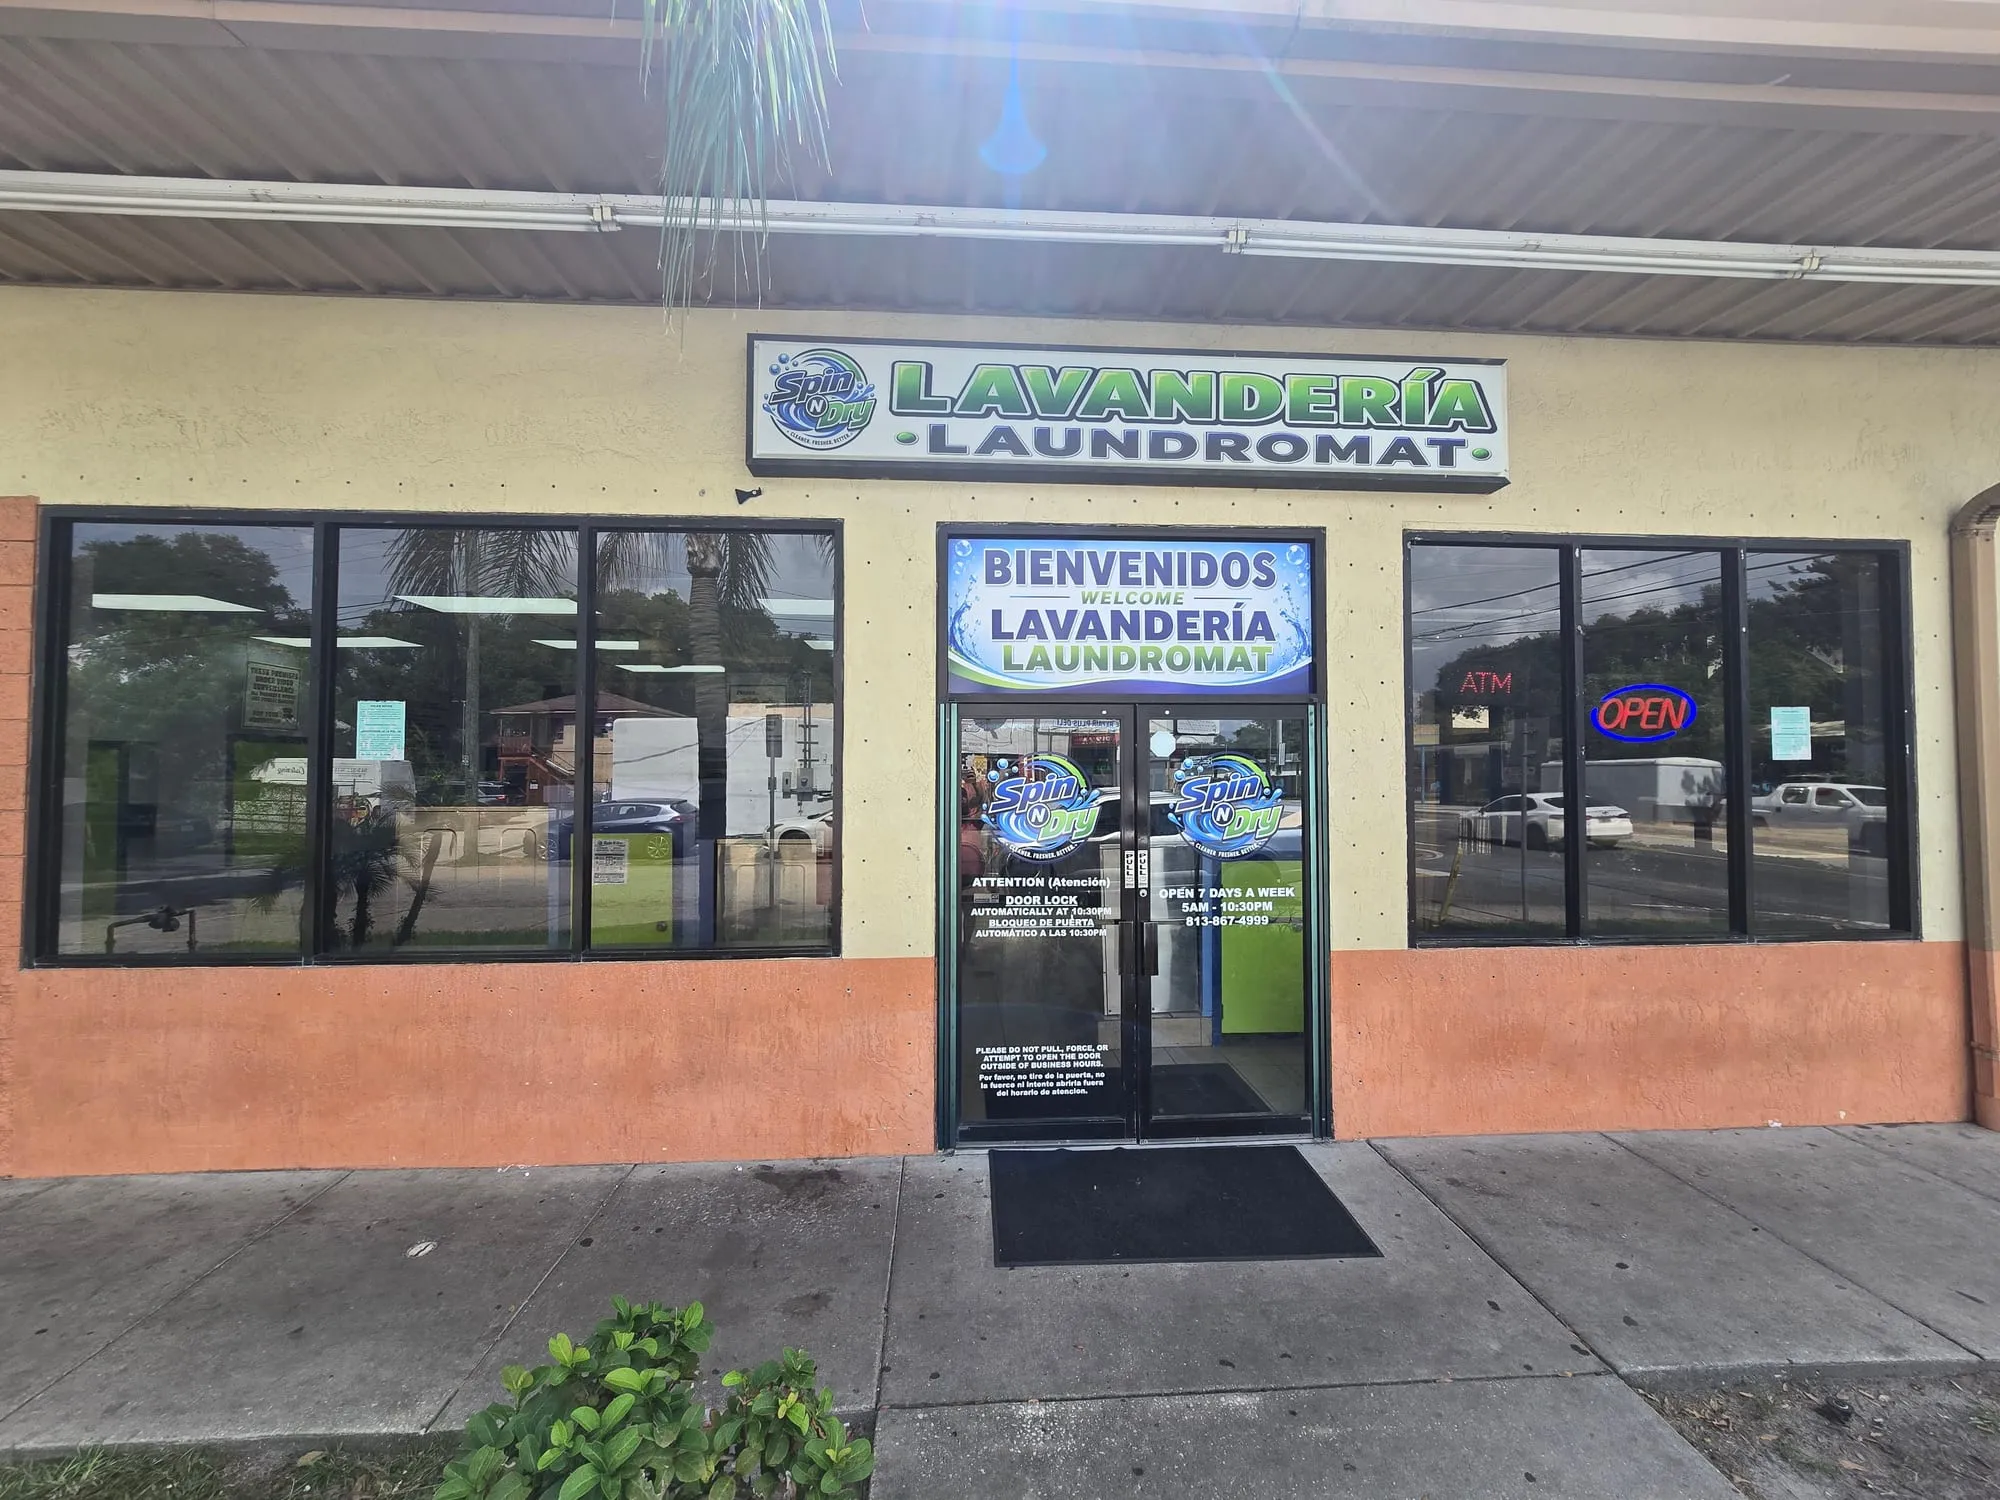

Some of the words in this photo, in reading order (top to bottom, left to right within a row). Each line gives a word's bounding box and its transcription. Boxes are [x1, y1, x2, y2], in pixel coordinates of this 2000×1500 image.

[768, 367, 854, 404] Spin
[891, 361, 1495, 431] LAVANDERÍA
[815, 398, 877, 430] Dry
[928, 423, 1468, 467] LAUNDROMAT
[984, 548, 1277, 588] BIENVENIDOS
[1080, 591, 1185, 606] WELCOME
[990, 602, 1276, 642] LAVANDERÍA
[1003, 645, 1273, 672] LAUNDROMAT
[1460, 672, 1512, 694] ATM
[1598, 697, 1688, 730] OPEN
[988, 773, 1078, 814] Spin
[1175, 773, 1260, 813] Spin
[1038, 806, 1100, 841] Dry
[1222, 805, 1284, 840] Dry
[972, 878, 1045, 887] ATTENTION
[1048, 877, 1110, 888] (Atención)
[1159, 888, 1194, 899] OPEN
[1198, 889, 1205, 898] 7
[1209, 888, 1242, 898] DAYS
[1245, 888, 1254, 897] A
[1258, 887, 1295, 897] WEEK
[971, 908, 1053, 916] AUTOMATICALLY
[1072, 907, 1112, 915] 10:30PM
[1005, 896, 1041, 905] DOOR
[1044, 895, 1078, 905] LOCK
[1182, 902, 1209, 912] 5AM
[1220, 902, 1272, 912] 10:30PM
[976, 928, 1037, 937] AUTOMÁTICO
[989, 919, 1037, 927] BLOQUEO
[1055, 918, 1094, 927] PUERTA
[1186, 916, 1269, 926] 813-867-4999
[1066, 1072, 1093, 1080] puerta,
